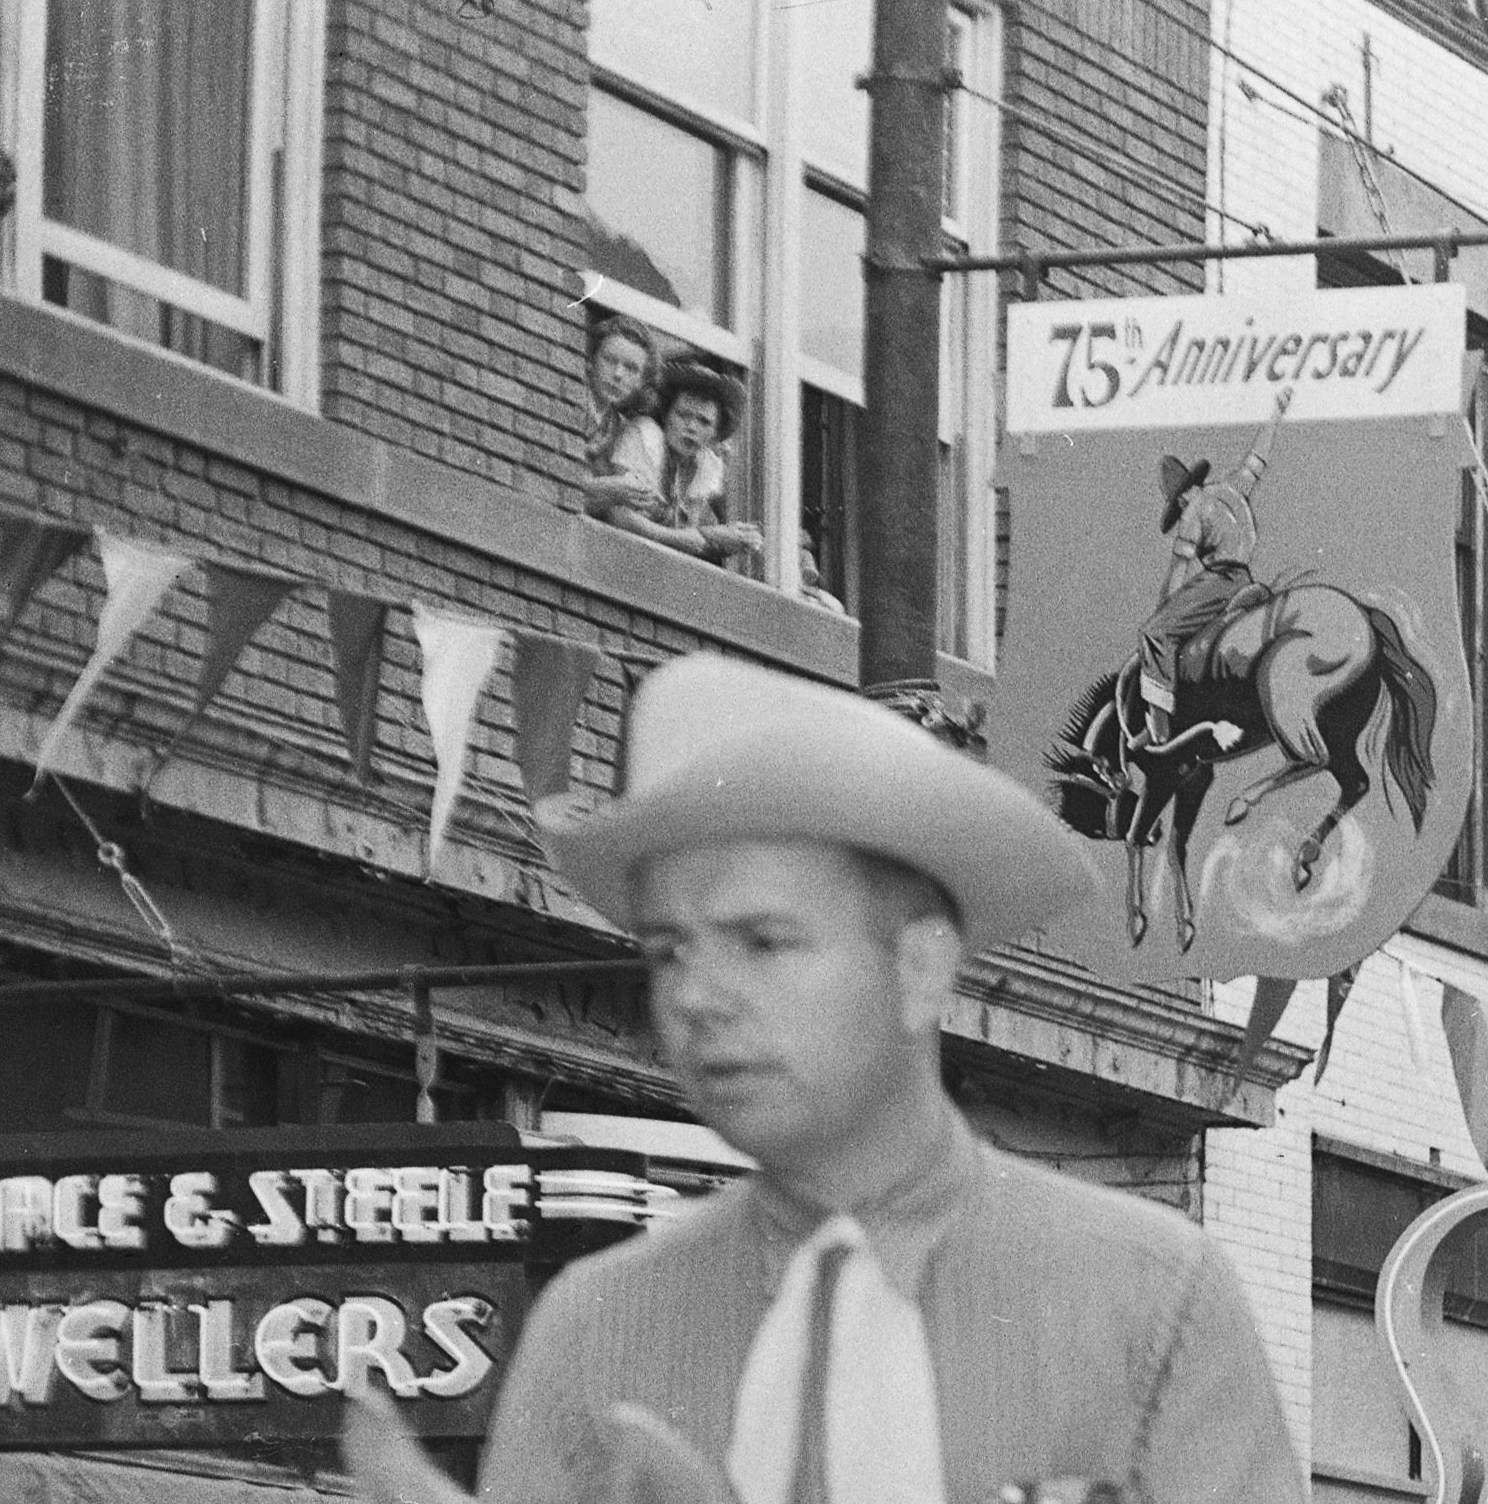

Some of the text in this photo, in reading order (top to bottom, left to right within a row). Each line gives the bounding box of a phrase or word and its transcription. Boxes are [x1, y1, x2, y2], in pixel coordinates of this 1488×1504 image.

[1128, 317, 1426, 398] Anniversary
[163, 1171, 241, 1249] &
[249, 1164, 533, 1246] STEELE
